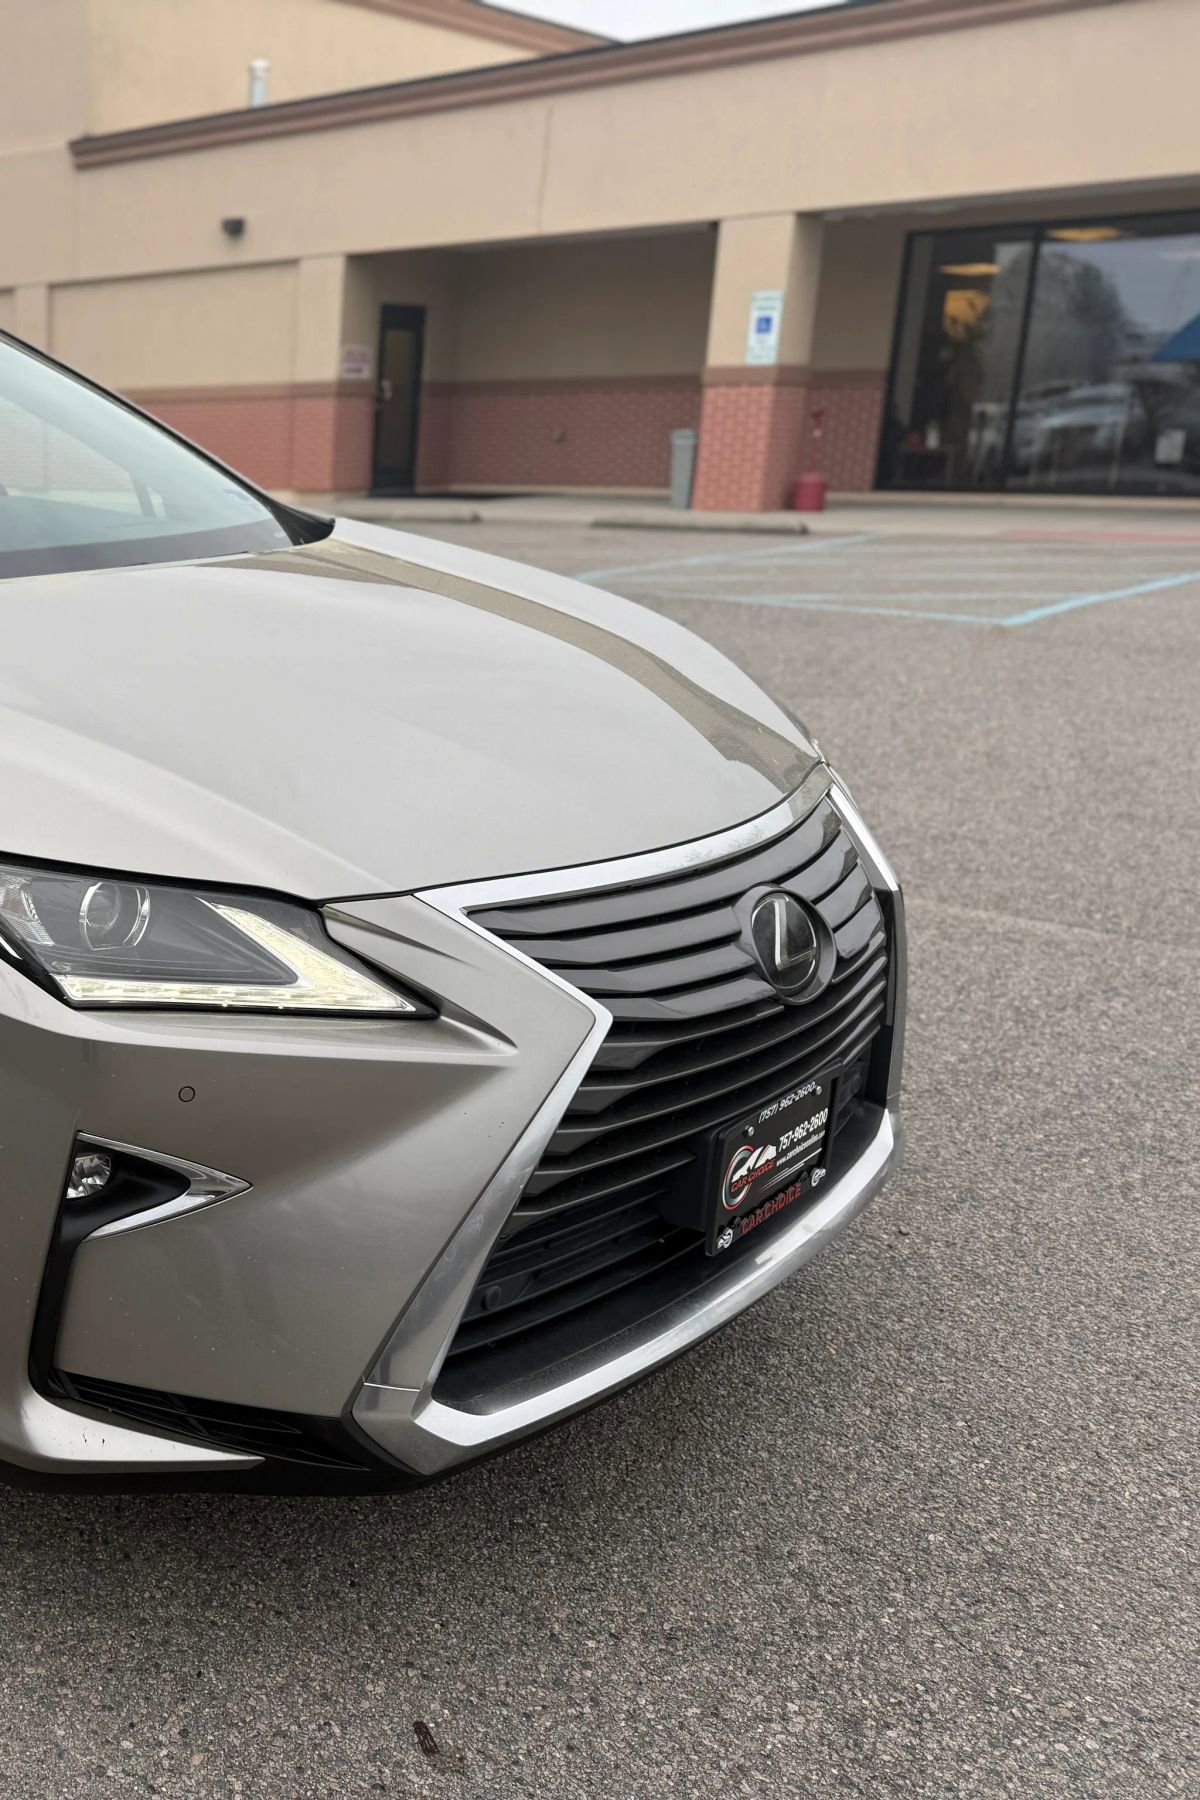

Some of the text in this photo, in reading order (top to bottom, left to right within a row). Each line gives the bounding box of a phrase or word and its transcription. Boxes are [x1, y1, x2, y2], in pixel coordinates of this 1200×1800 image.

[758, 1103, 779, 1124] (757)
[778, 1108, 829, 1152] 757-962-2600
[730, 1158, 776, 1193] CAR CHOICE
[739, 1182, 802, 1236] CAR CHOICE
